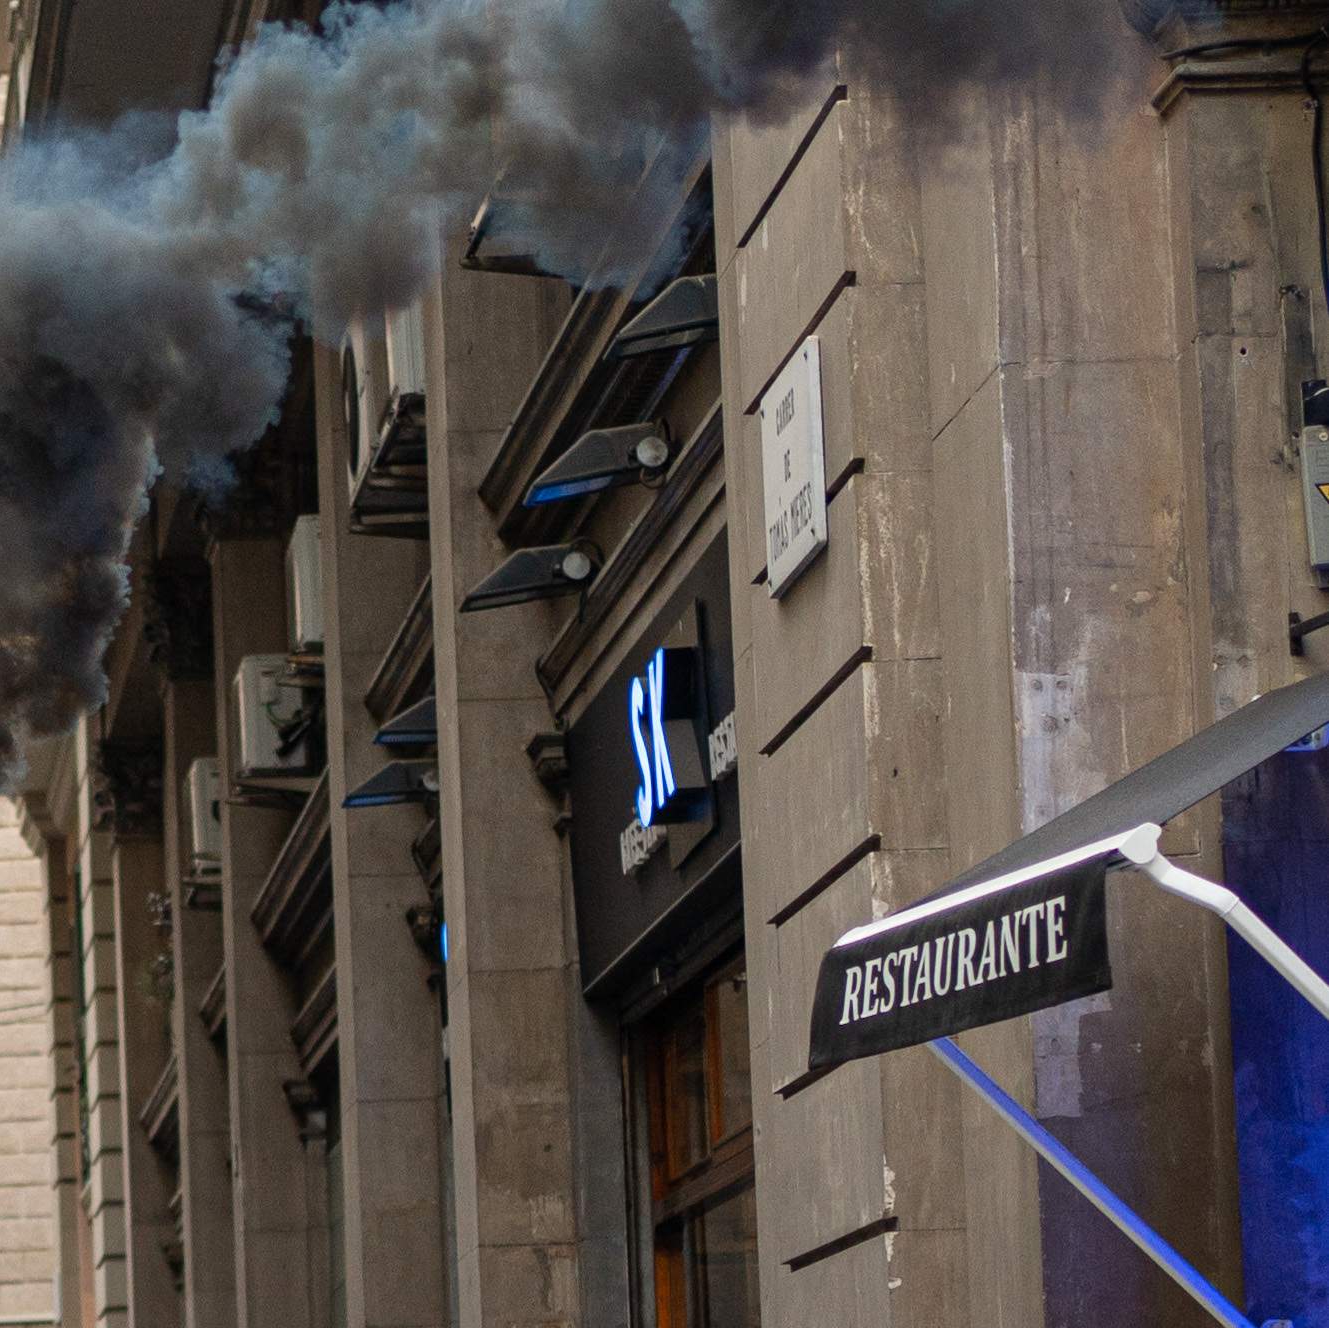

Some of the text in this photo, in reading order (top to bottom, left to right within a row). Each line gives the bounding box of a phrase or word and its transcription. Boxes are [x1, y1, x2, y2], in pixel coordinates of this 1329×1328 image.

[775, 387, 795, 437] CARRER
[783, 449, 791, 483] DE
[630, 646, 675, 828] SK
[839, 895, 1068, 1026] RESTAURANTE
